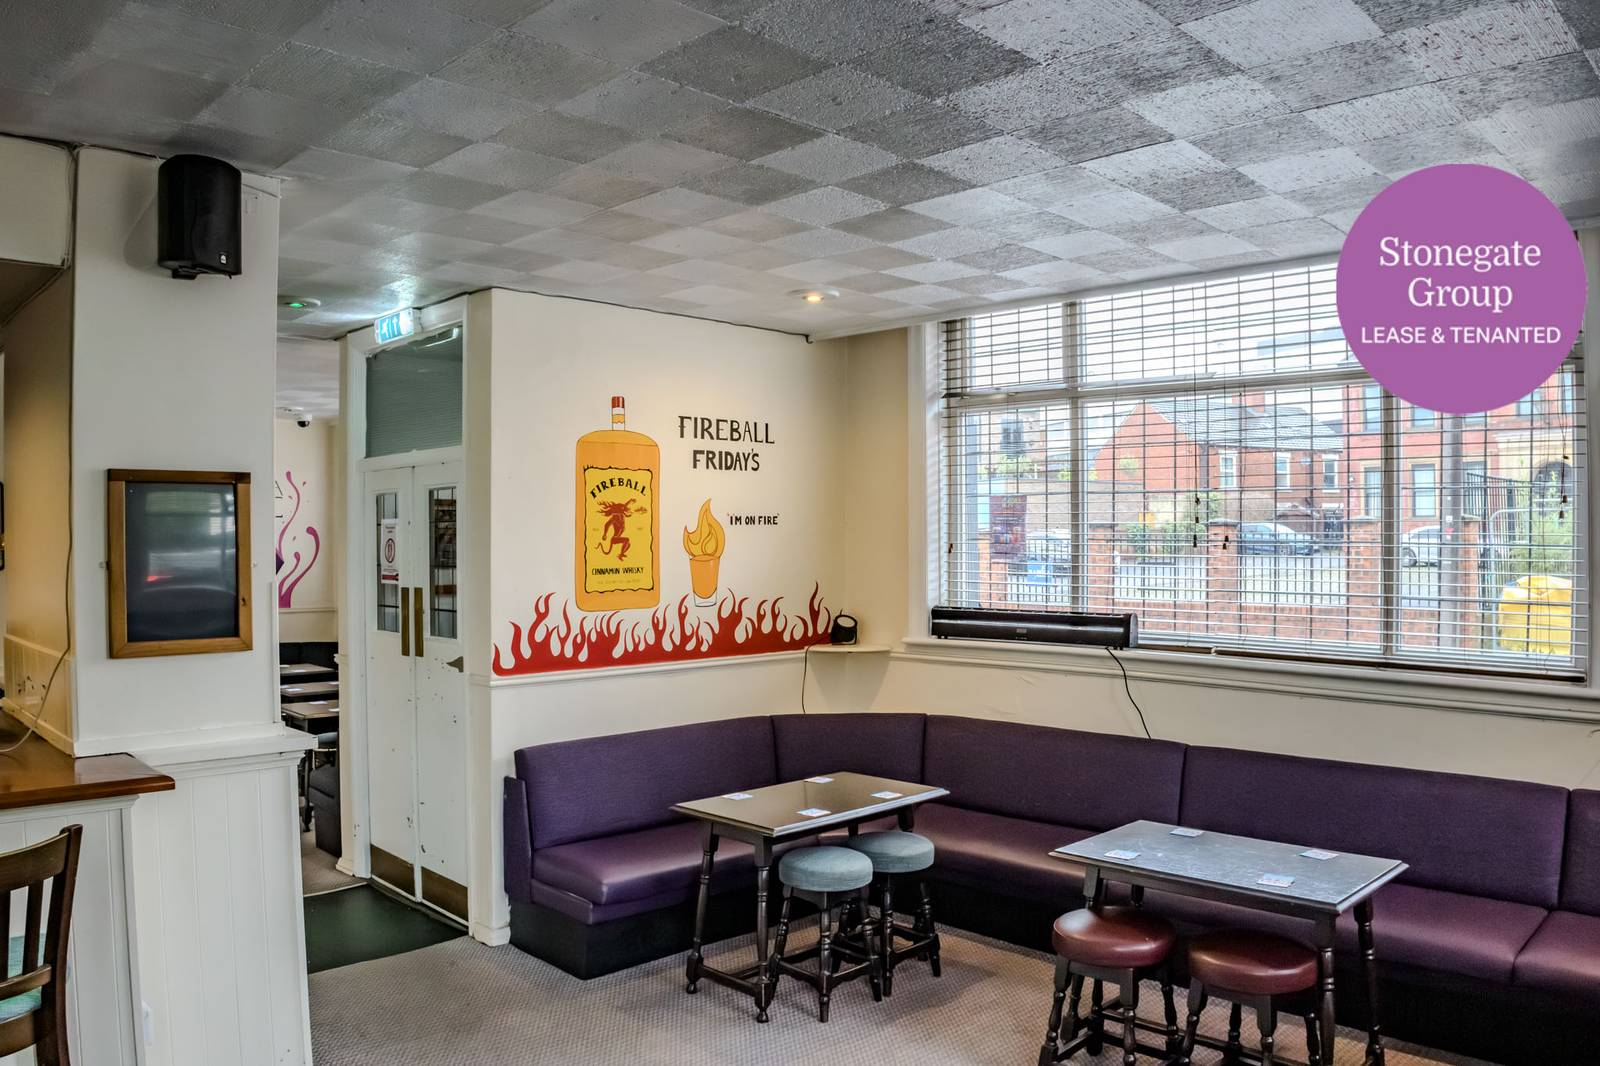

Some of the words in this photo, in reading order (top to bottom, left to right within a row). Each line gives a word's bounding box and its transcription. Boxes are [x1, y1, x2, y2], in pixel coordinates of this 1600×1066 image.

[678, 415, 775, 444] FIREBALL
[693, 448, 760, 471] FRIDAY'S
[590, 478, 646, 498] FIREBALL
[745, 516, 756, 526] ON
